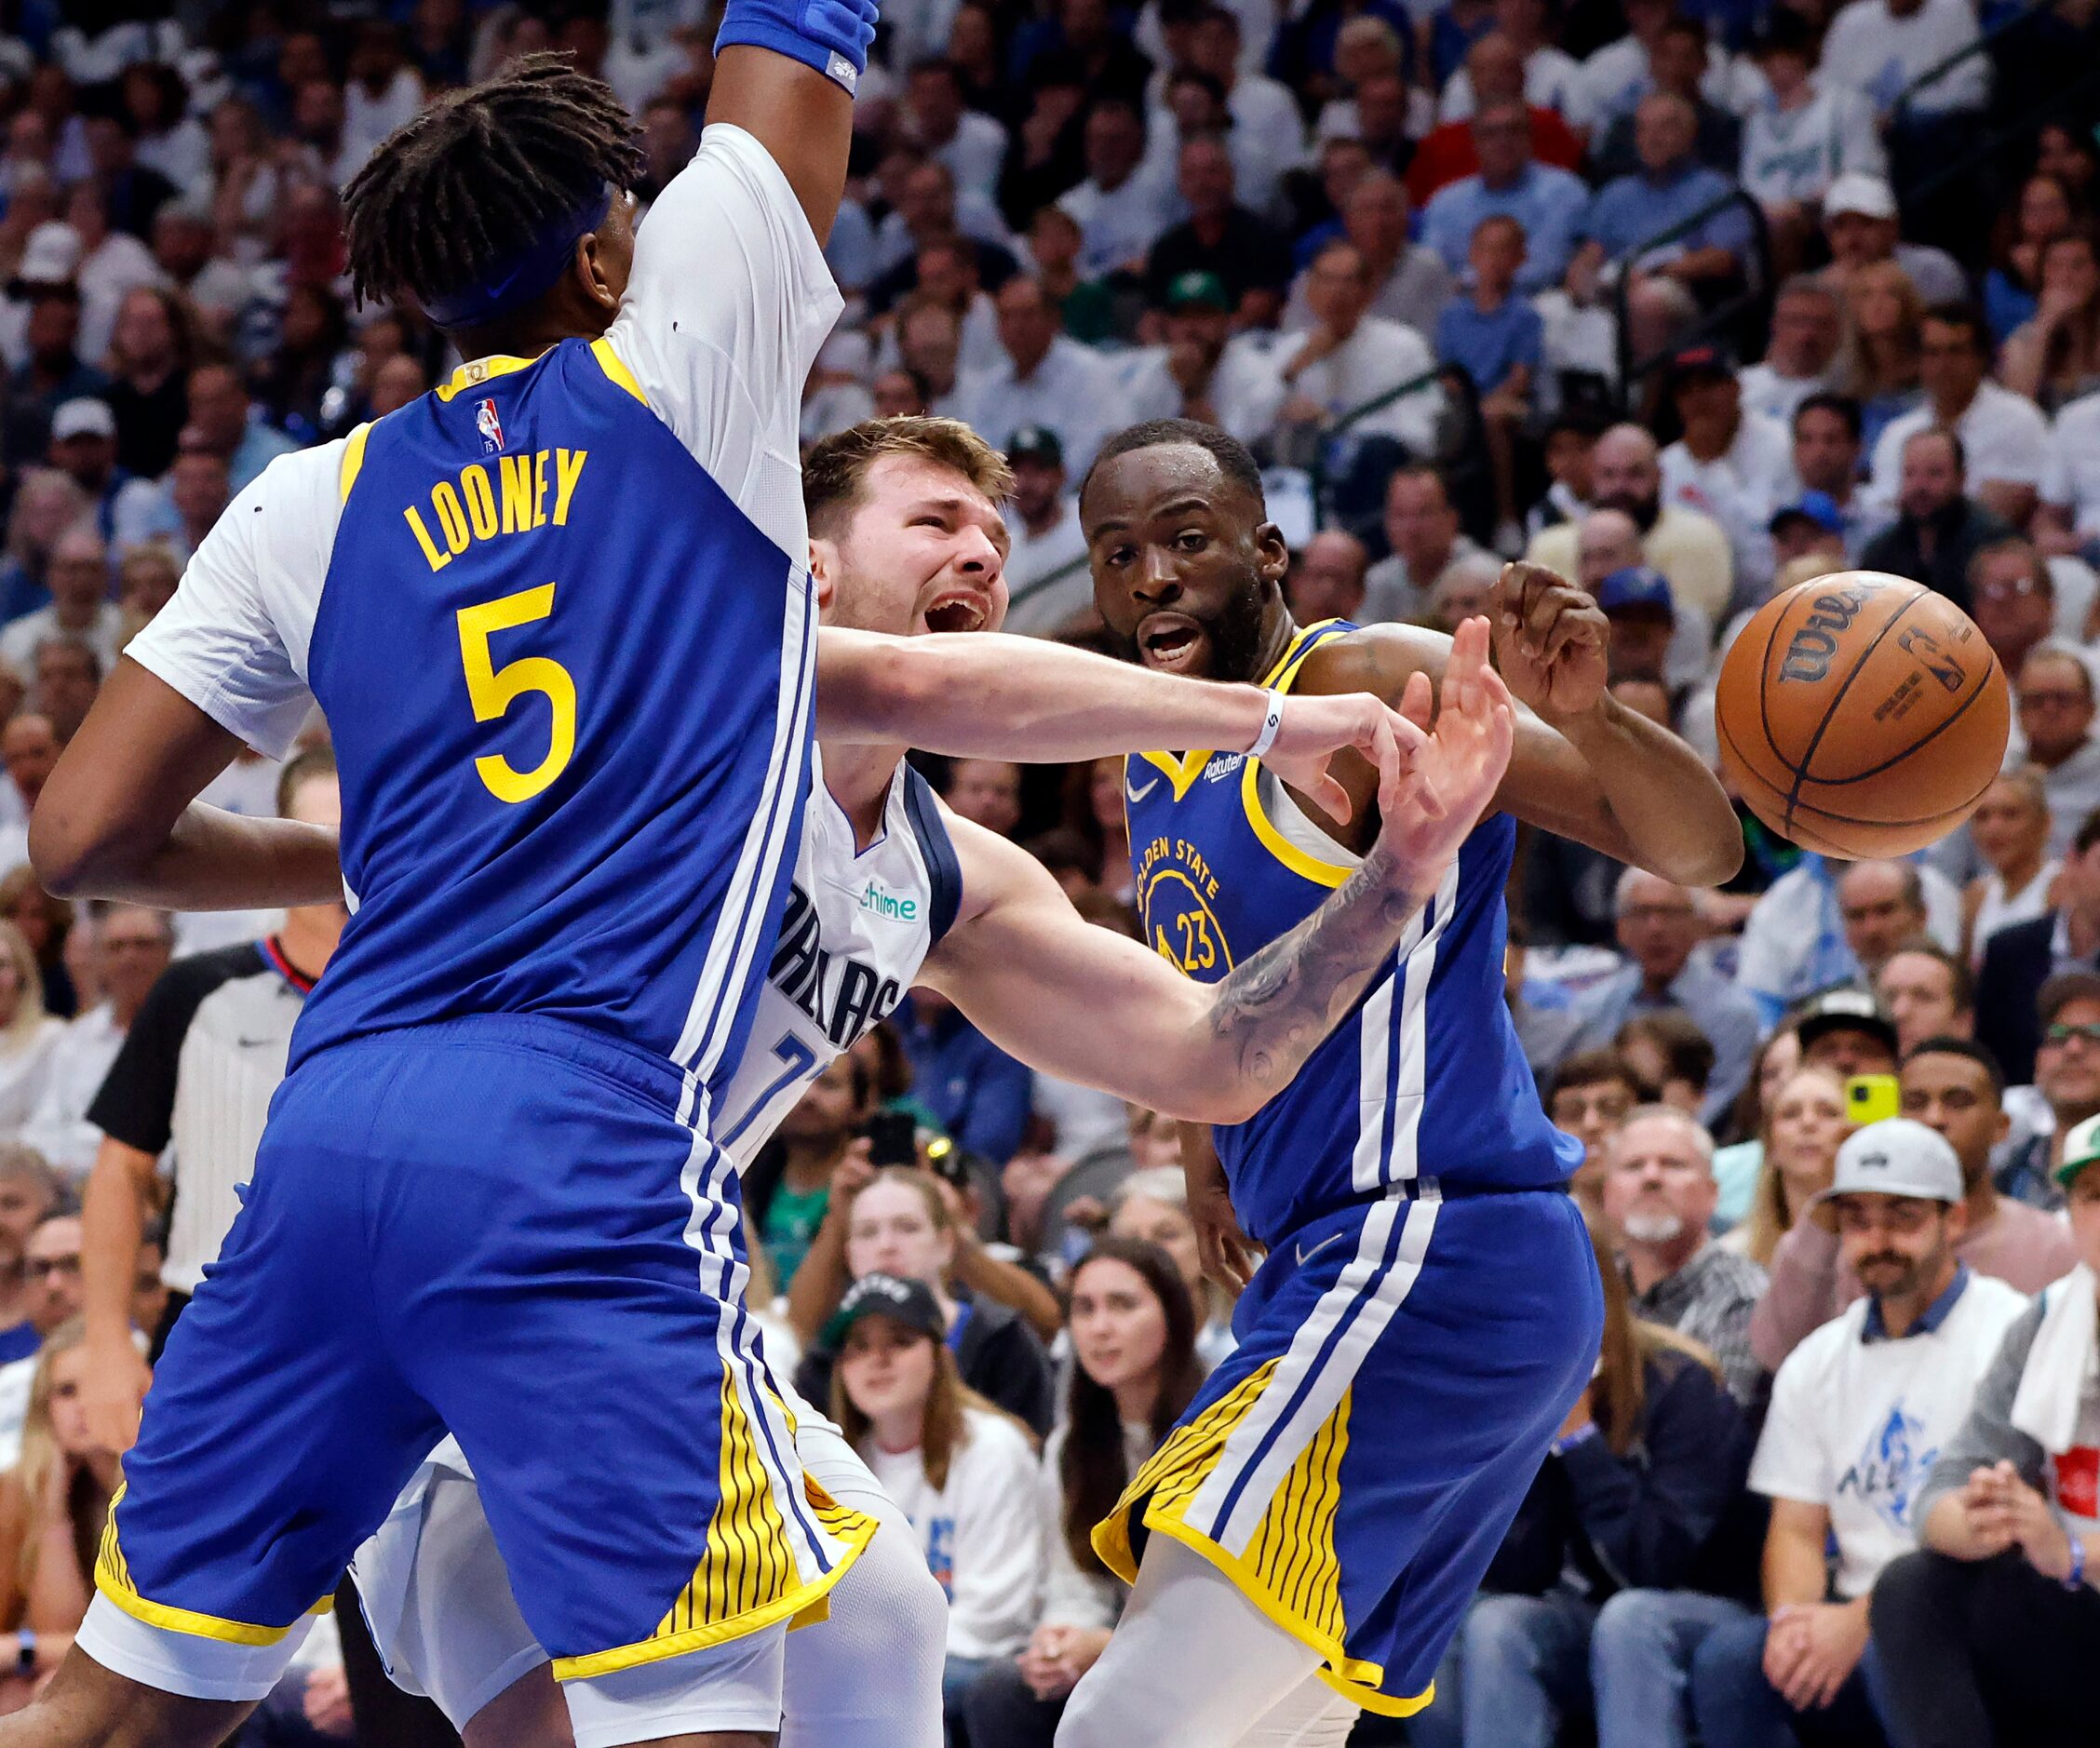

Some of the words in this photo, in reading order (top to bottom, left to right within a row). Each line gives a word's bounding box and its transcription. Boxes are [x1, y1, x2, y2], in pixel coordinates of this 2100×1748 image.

[484, 440, 494, 453] 75
[403, 448, 588, 572] LOONEY
[456, 582, 577, 803] 5
[1204, 754, 1243, 780] Rakuten
[1137, 837, 1170, 913] GOLDEN
[1176, 839, 1219, 900] STATE
[1177, 909, 1216, 970] 23
